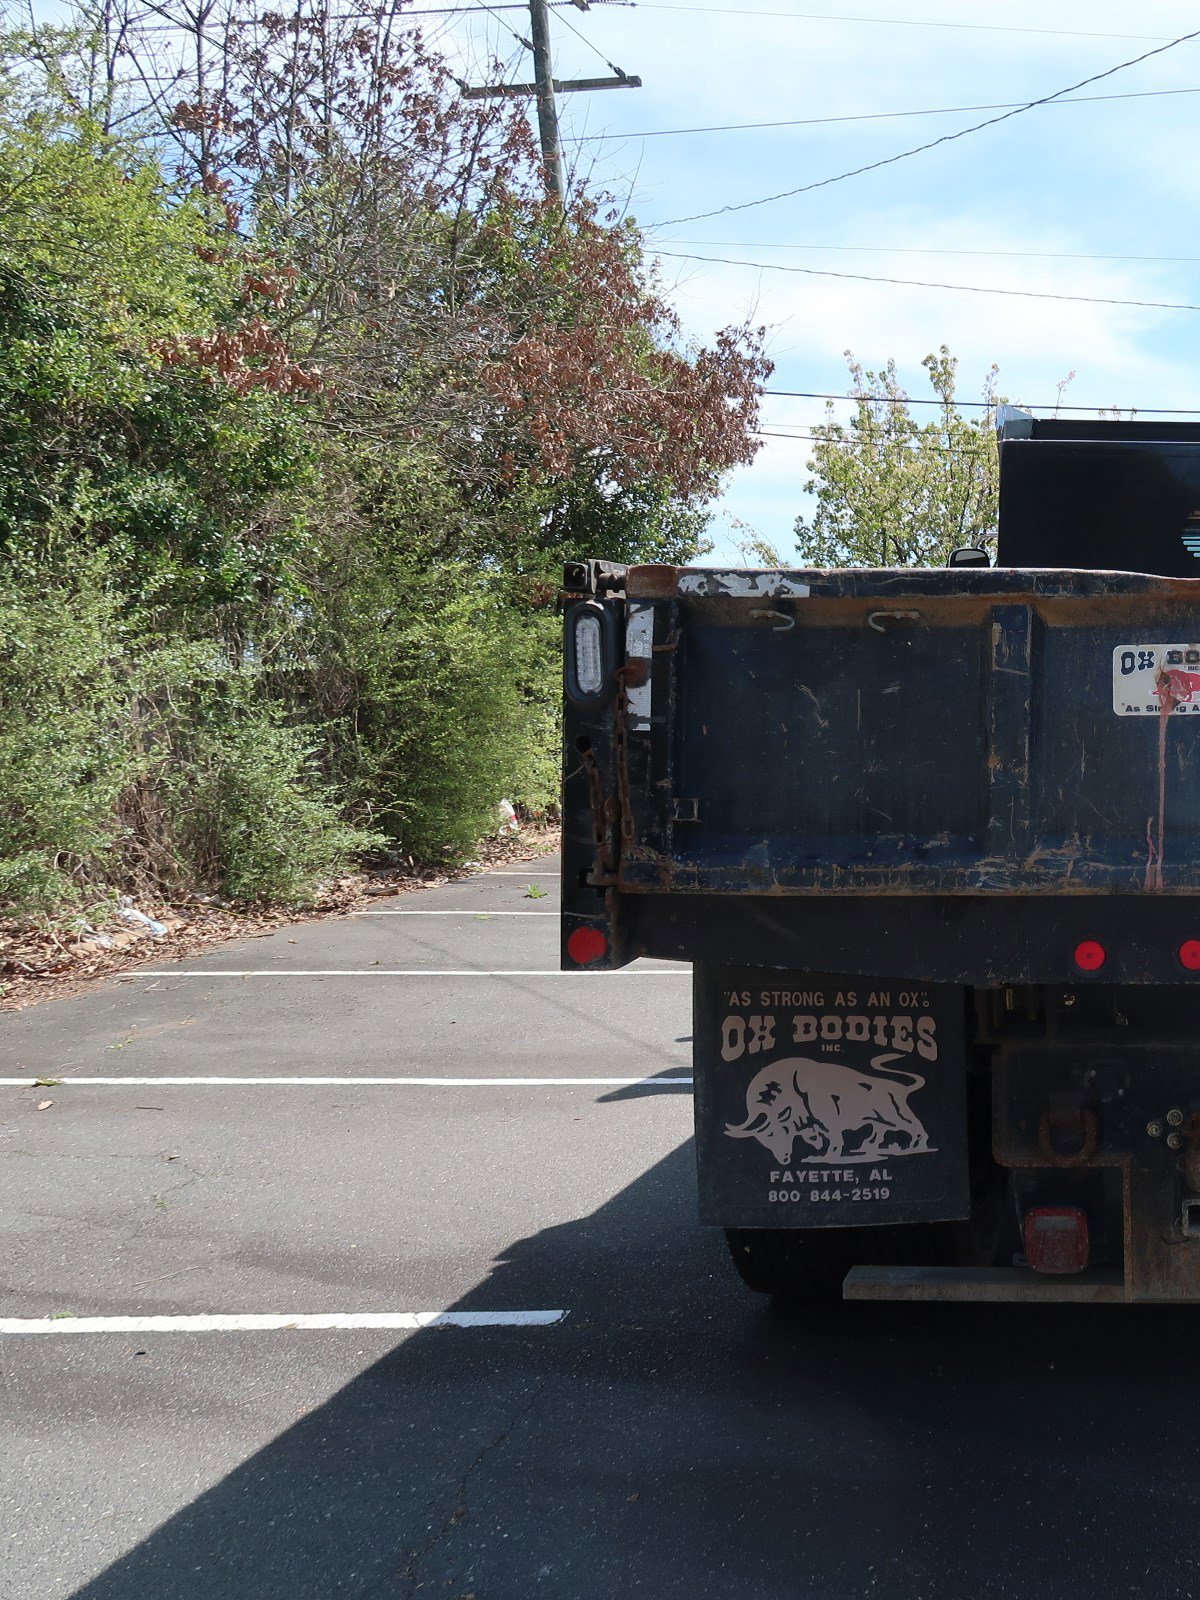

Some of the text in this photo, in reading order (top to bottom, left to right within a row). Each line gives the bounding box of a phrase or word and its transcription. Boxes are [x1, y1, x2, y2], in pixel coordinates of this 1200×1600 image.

[1120, 651, 1155, 675] OX
[760, 991, 825, 1006] STRONG
[834, 991, 857, 1007] AS
[867, 991, 891, 1007] AN
[721, 1015, 938, 1062] OX BODIES
[769, 1168, 893, 1185] FAYETTE, AL
